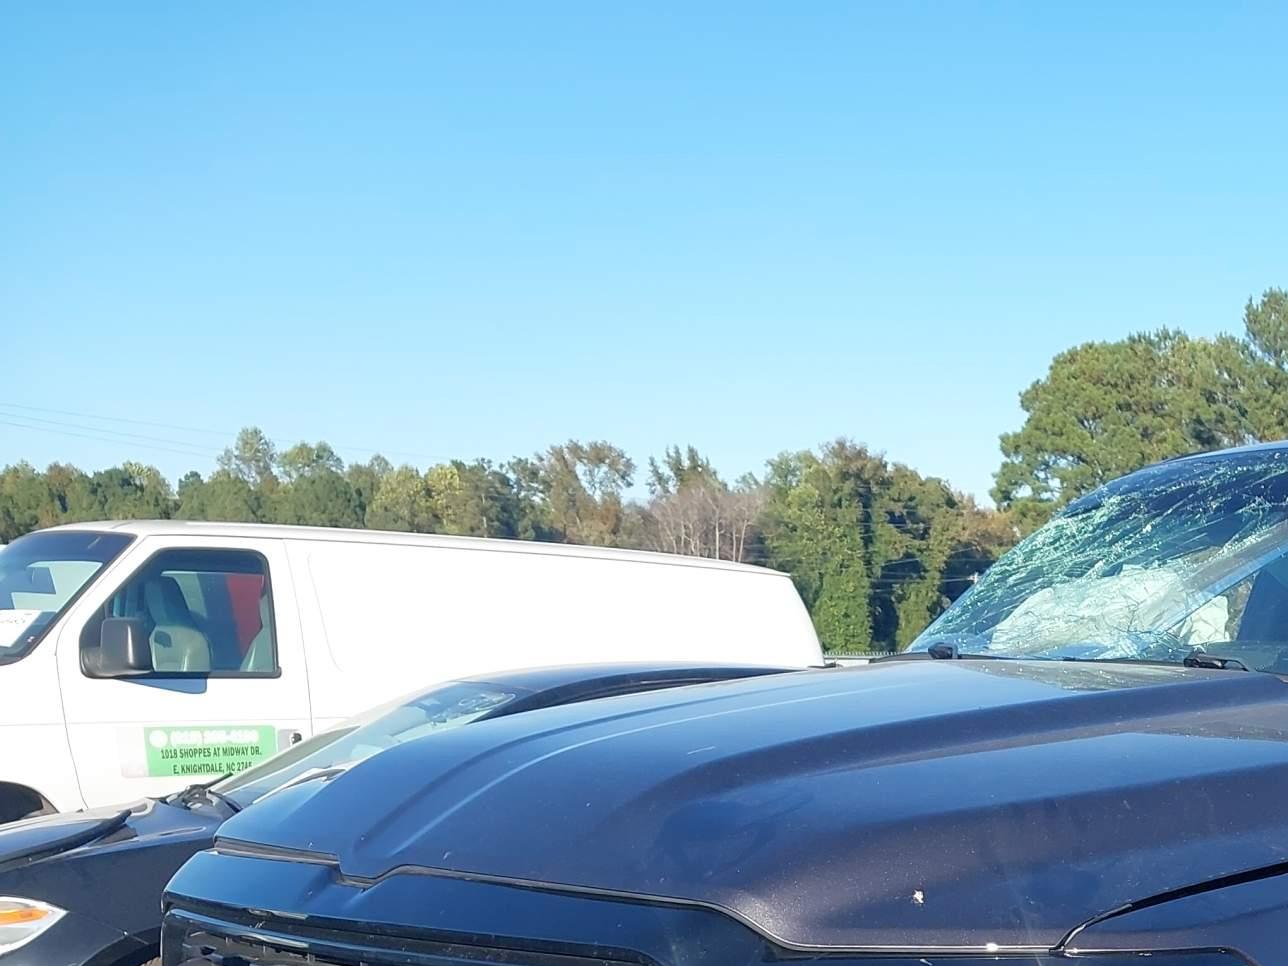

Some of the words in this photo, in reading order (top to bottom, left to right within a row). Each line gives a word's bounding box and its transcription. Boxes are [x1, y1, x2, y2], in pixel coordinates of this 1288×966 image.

[161, 748, 178, 759] 1018
[180, 747, 211, 759] SHOPPES
[213, 747, 221, 758] AT
[222, 746, 249, 757] MIDWAY
[250, 745, 262, 756] DR.
[181, 763, 225, 775] KNIGHTDALE,
[226, 761, 236, 772] NC
